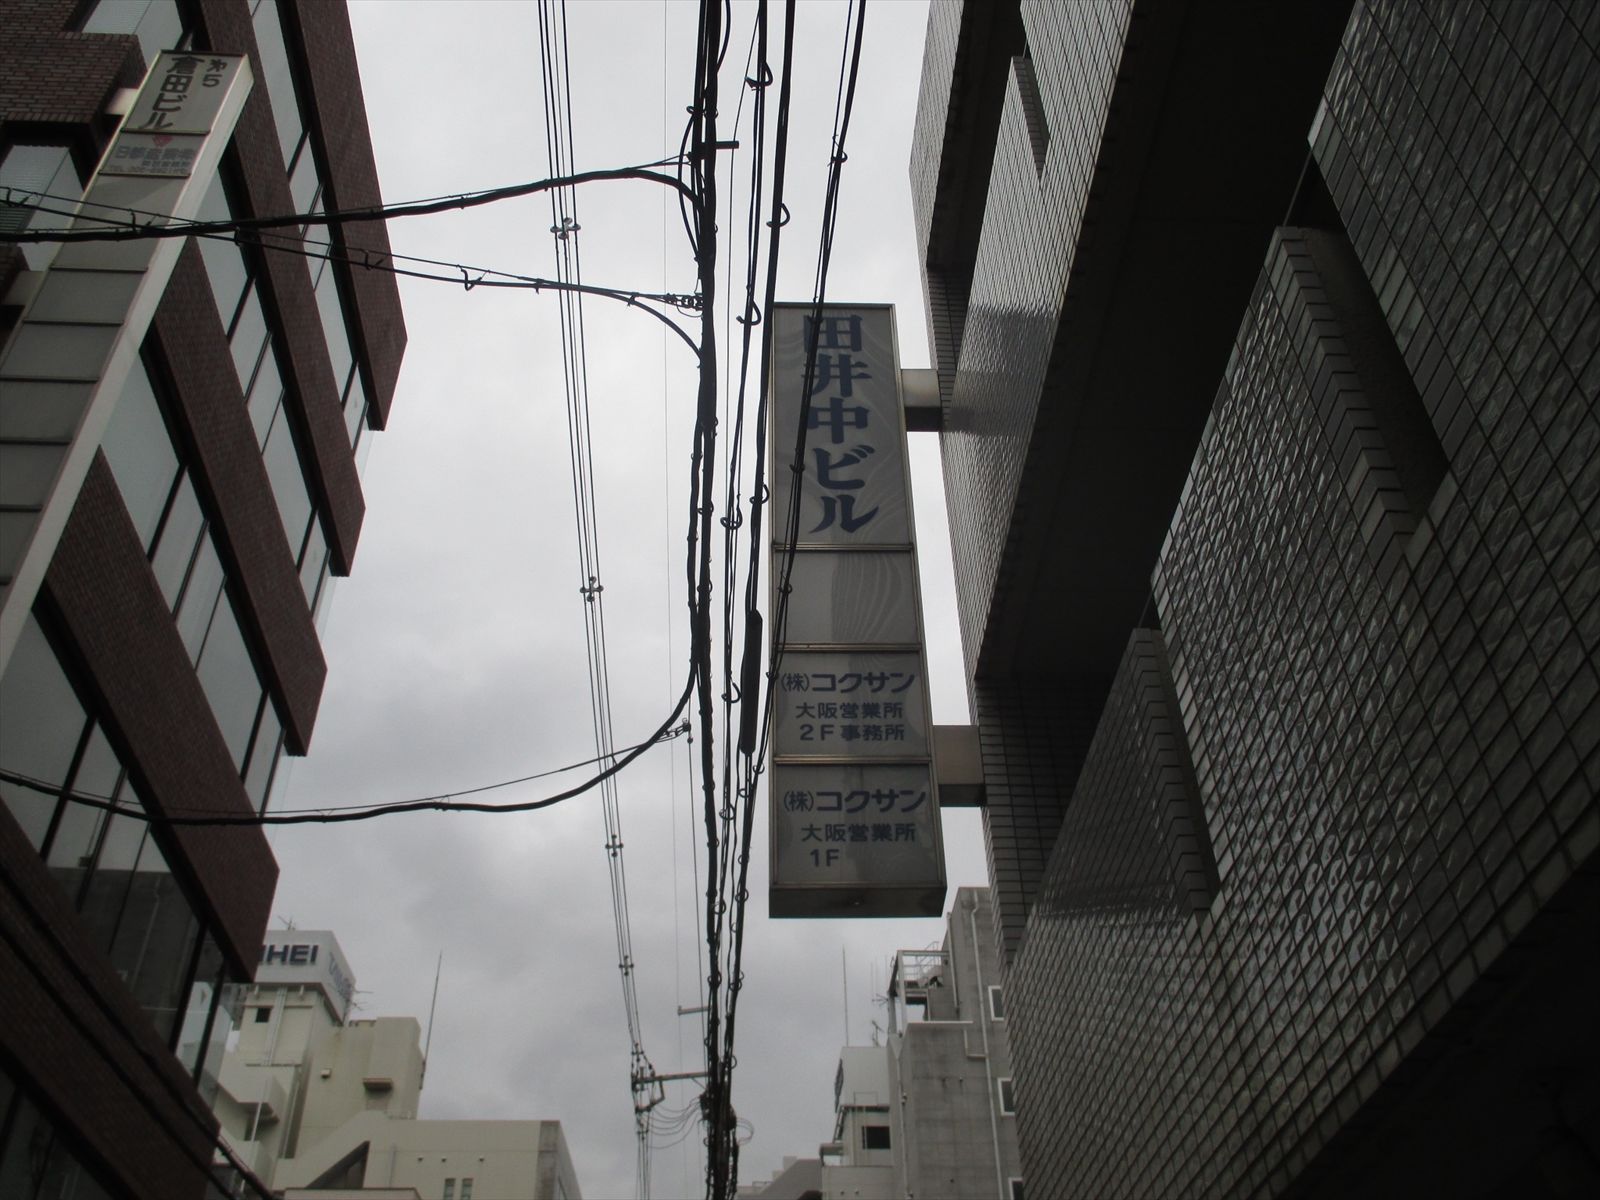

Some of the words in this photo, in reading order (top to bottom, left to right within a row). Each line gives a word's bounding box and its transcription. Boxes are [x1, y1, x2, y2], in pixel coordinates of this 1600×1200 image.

[800, 314, 879, 533] 田井中ビル
[780, 671, 916, 694] (株)コクサン
[795, 702, 904, 719] 大阪営業所
[783, 788, 927, 813] (株)コクサン
[801, 824, 917, 843] 大阪営業所
[810, 849, 841, 867] 1F
